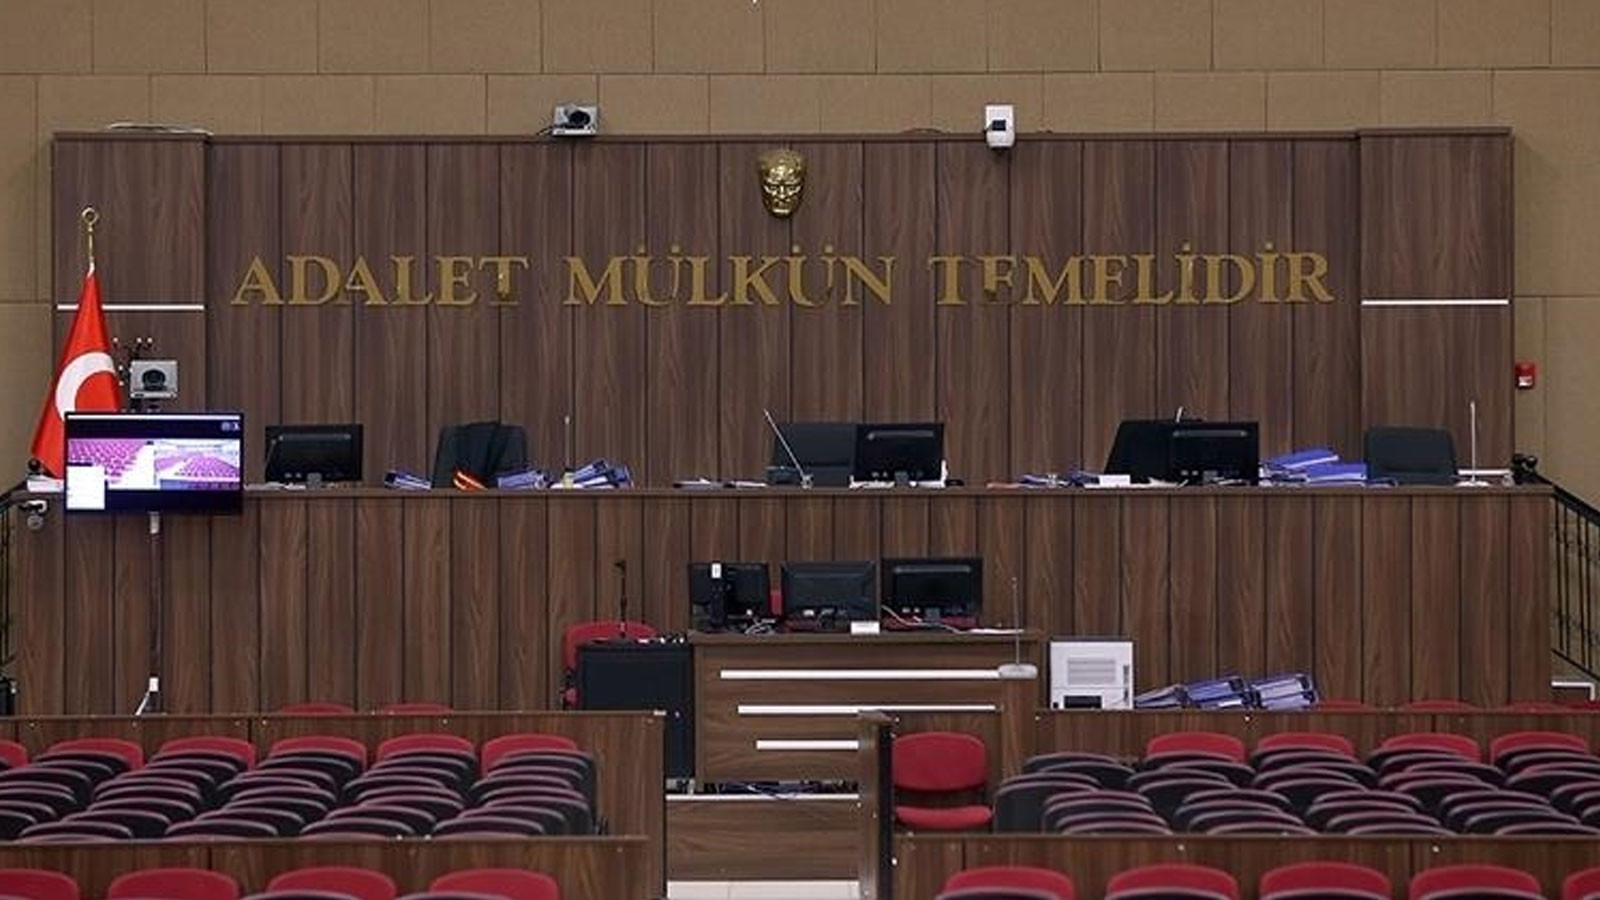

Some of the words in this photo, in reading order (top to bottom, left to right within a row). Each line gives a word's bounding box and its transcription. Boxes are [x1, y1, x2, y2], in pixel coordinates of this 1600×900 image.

[231, 255, 529, 306] ADALET
[564, 244, 896, 307] MÜLKÜN
[928, 242, 1335, 305] TEMELİDİR
